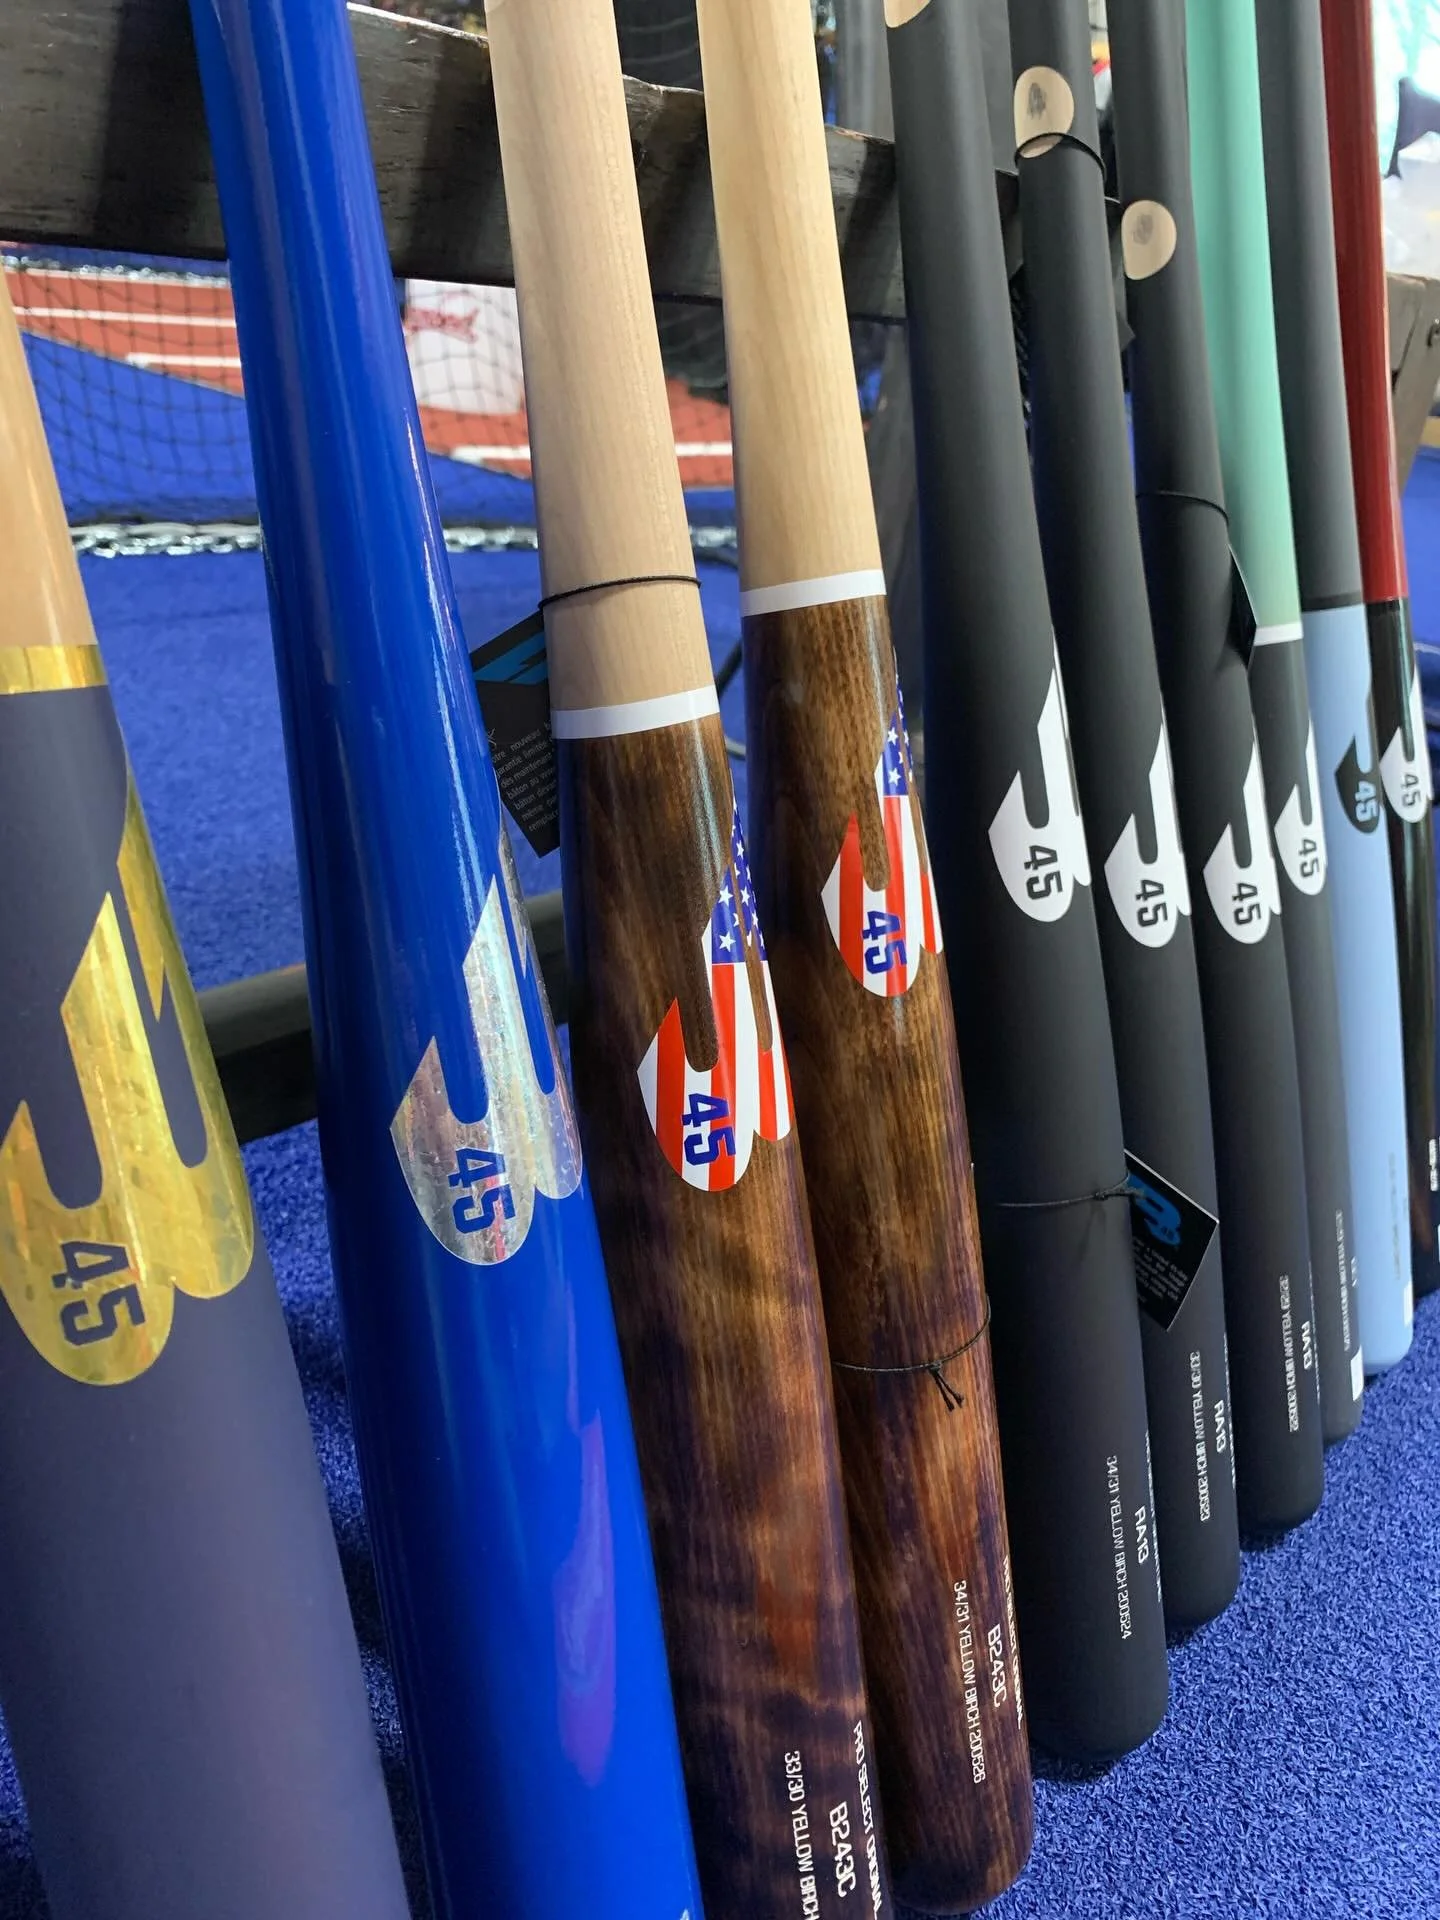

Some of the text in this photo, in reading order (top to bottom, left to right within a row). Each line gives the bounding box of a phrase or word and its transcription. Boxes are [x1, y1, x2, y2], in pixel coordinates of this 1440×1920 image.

[1354, 782, 1378, 823] 45
[1399, 773, 1422, 808] 45
[1023, 844, 1063, 901] 45
[1298, 837, 1320, 878] 45
[1135, 878, 1168, 928] 45
[1231, 882, 1262, 926] 45
[862, 910, 907, 975] 45
[681, 1092, 736, 1167] 45
[447, 1146, 516, 1235] 45
[59, 1240, 145, 1347] 45
[1301, 1321, 1313, 1370] RA13
[1192, 1390, 1206, 1439] YELLOW
[1213, 1399, 1228, 1453] RA13
[1105, 1455, 1133, 1640] 34/31 YELLOW BIRCH 200524
[1134, 1505, 1150, 1564] RA13
[953, 1580, 986, 1784] 34/31 YELLOW BIRCH 200526
[987, 1624, 1007, 1708] B243C
[784, 1750, 820, 1920] 33/30 YELLOW BIRCH
[829, 1801, 857, 1898] B243C
[853, 1720, 883, 1920] PRO SELECT ORIGINAL
